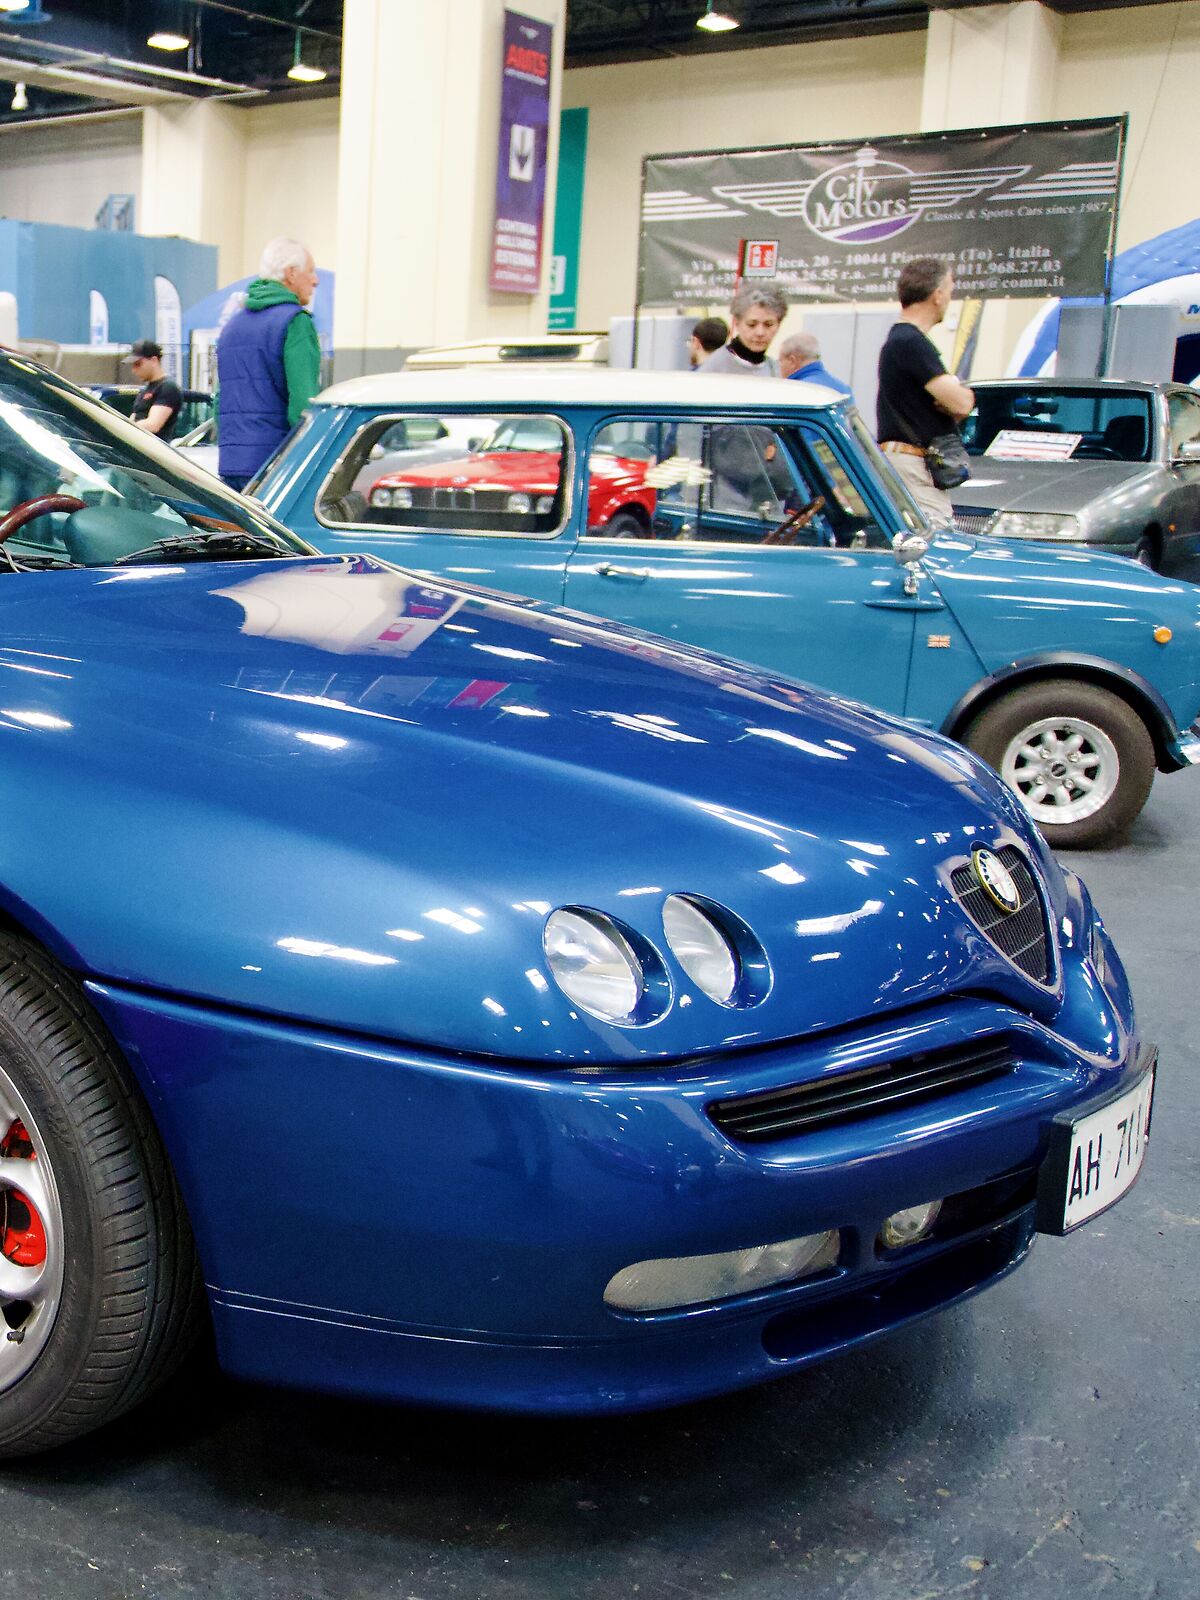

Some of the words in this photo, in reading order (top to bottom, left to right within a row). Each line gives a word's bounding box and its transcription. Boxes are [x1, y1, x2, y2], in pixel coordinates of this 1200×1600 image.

[825, 170, 879, 201] City
[815, 197, 907, 228] Motors
[980, 208, 1015, 222] Sports
[1018, 206, 1043, 217] Cars
[1046, 205, 1076, 216] since
[812, 254, 830, 267] 20
[845, 252, 887, 266] 10044
[960, 247, 993, 262] (To)
[1008, 244, 1052, 259] Italia
[1067, 1132, 1103, 1207] AH
